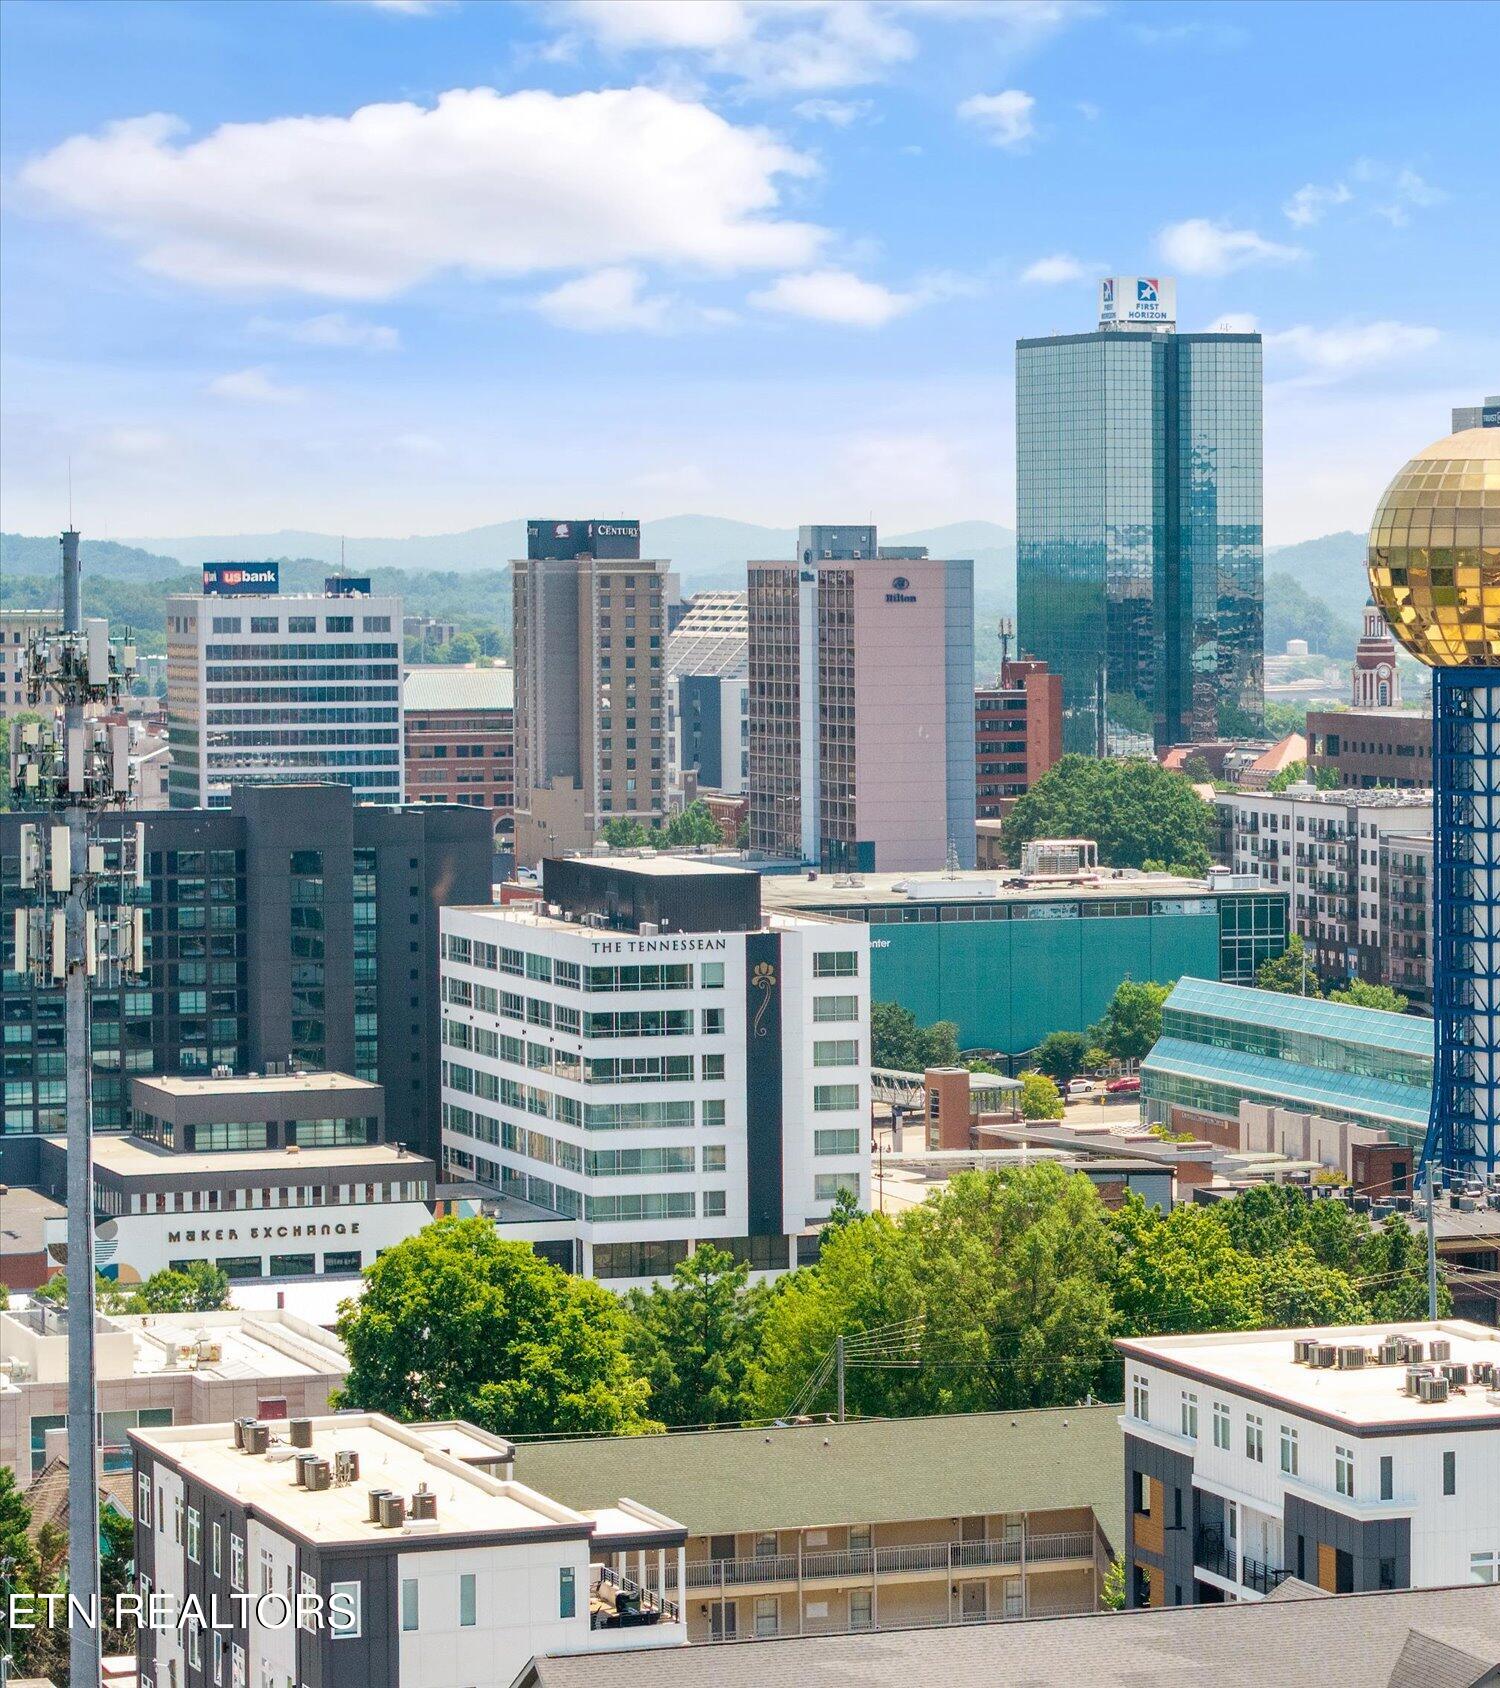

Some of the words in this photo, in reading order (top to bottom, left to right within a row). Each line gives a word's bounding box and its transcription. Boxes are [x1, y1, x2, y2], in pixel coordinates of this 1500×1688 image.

[886, 593, 917, 602] Hilton
[592, 942, 621, 954] THE
[628, 939, 727, 953] TENNESSEAN
[251, 1222, 360, 1238] EXCHANGE
